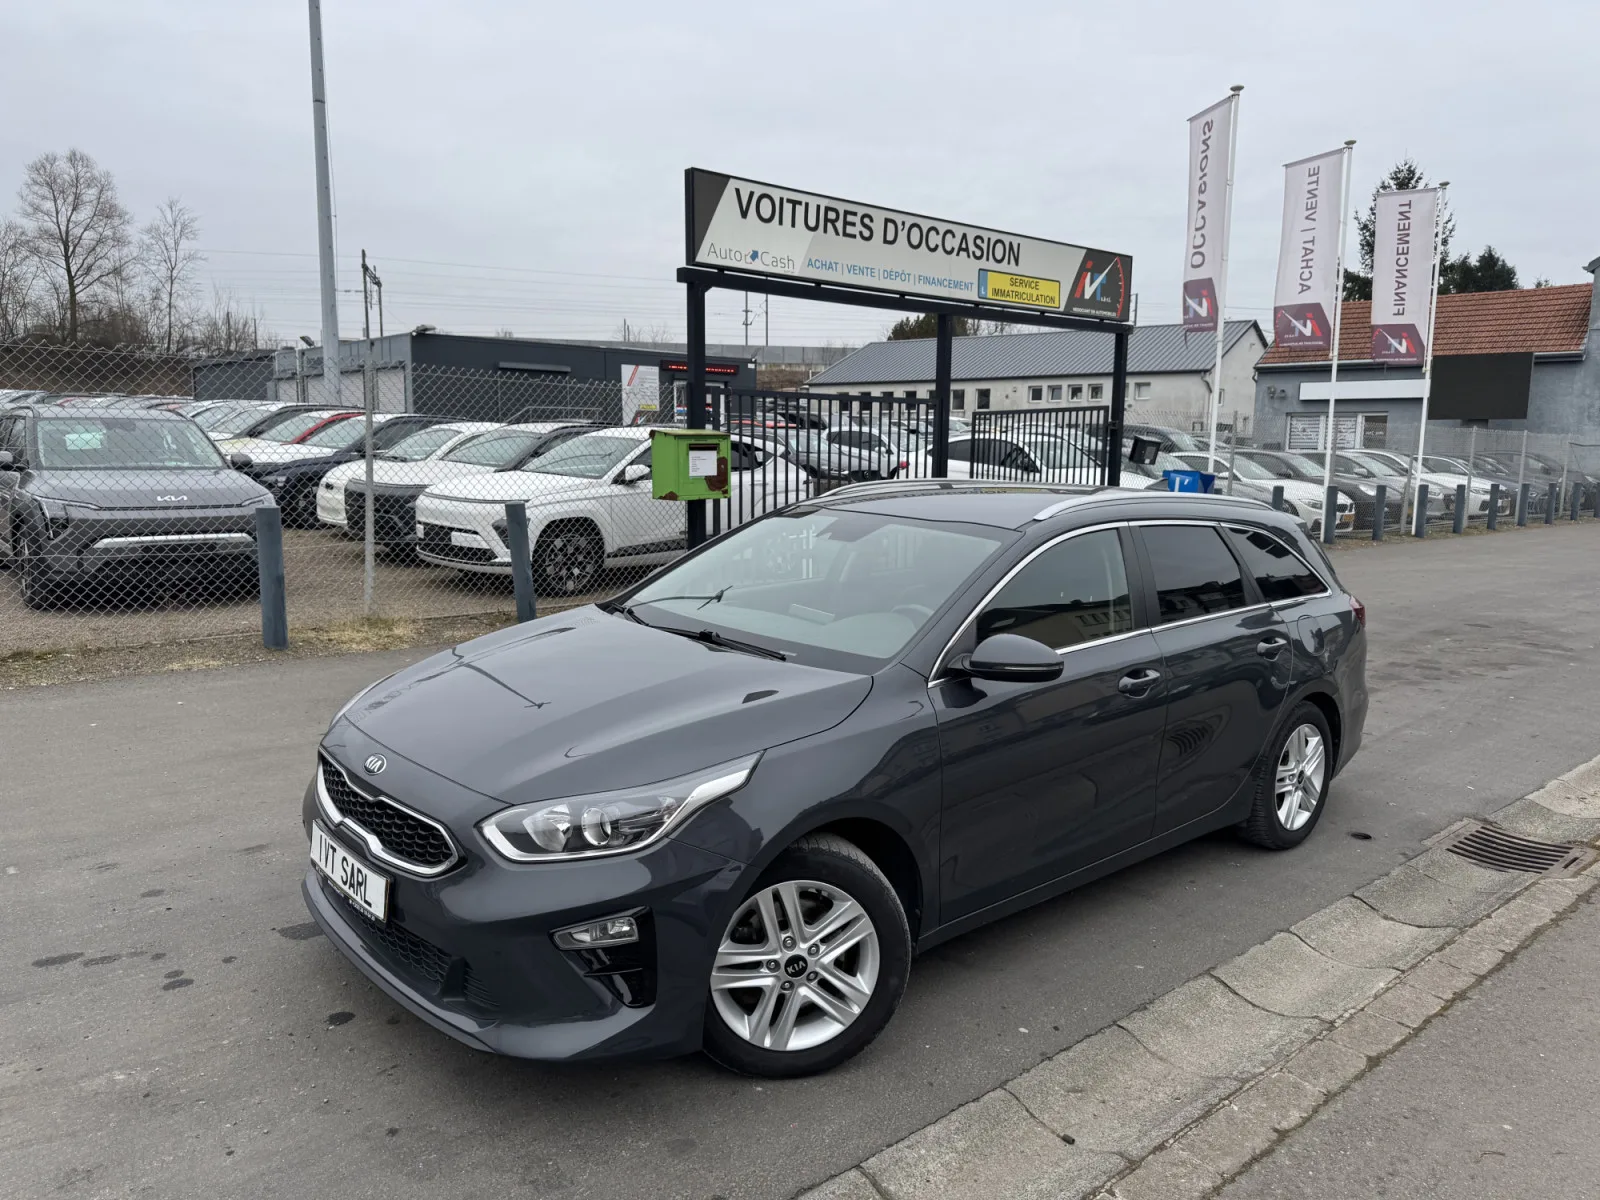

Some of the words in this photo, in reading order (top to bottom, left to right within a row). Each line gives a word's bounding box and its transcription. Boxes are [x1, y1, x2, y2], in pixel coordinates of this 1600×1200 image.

[735, 187, 874, 242] VOITURES
[882, 216, 1021, 267] D'OCCASION
[707, 242, 743, 263] Auto
[760, 251, 796, 270] Cash
[806, 257, 840, 274] ACHAT
[846, 263, 877, 279] VENTE
[882, 267, 912, 284] DÉPÔT
[917, 274, 975, 293] FINANCEMENT
[1009, 276, 1040, 291] SERVICE
[991, 287, 1056, 305] IMMATRICULATION
[364, 755, 383, 773] KIA
[318, 834, 337, 876] IVT
[340, 855, 373, 909] SARL
[786, 960, 807, 975] KIA
